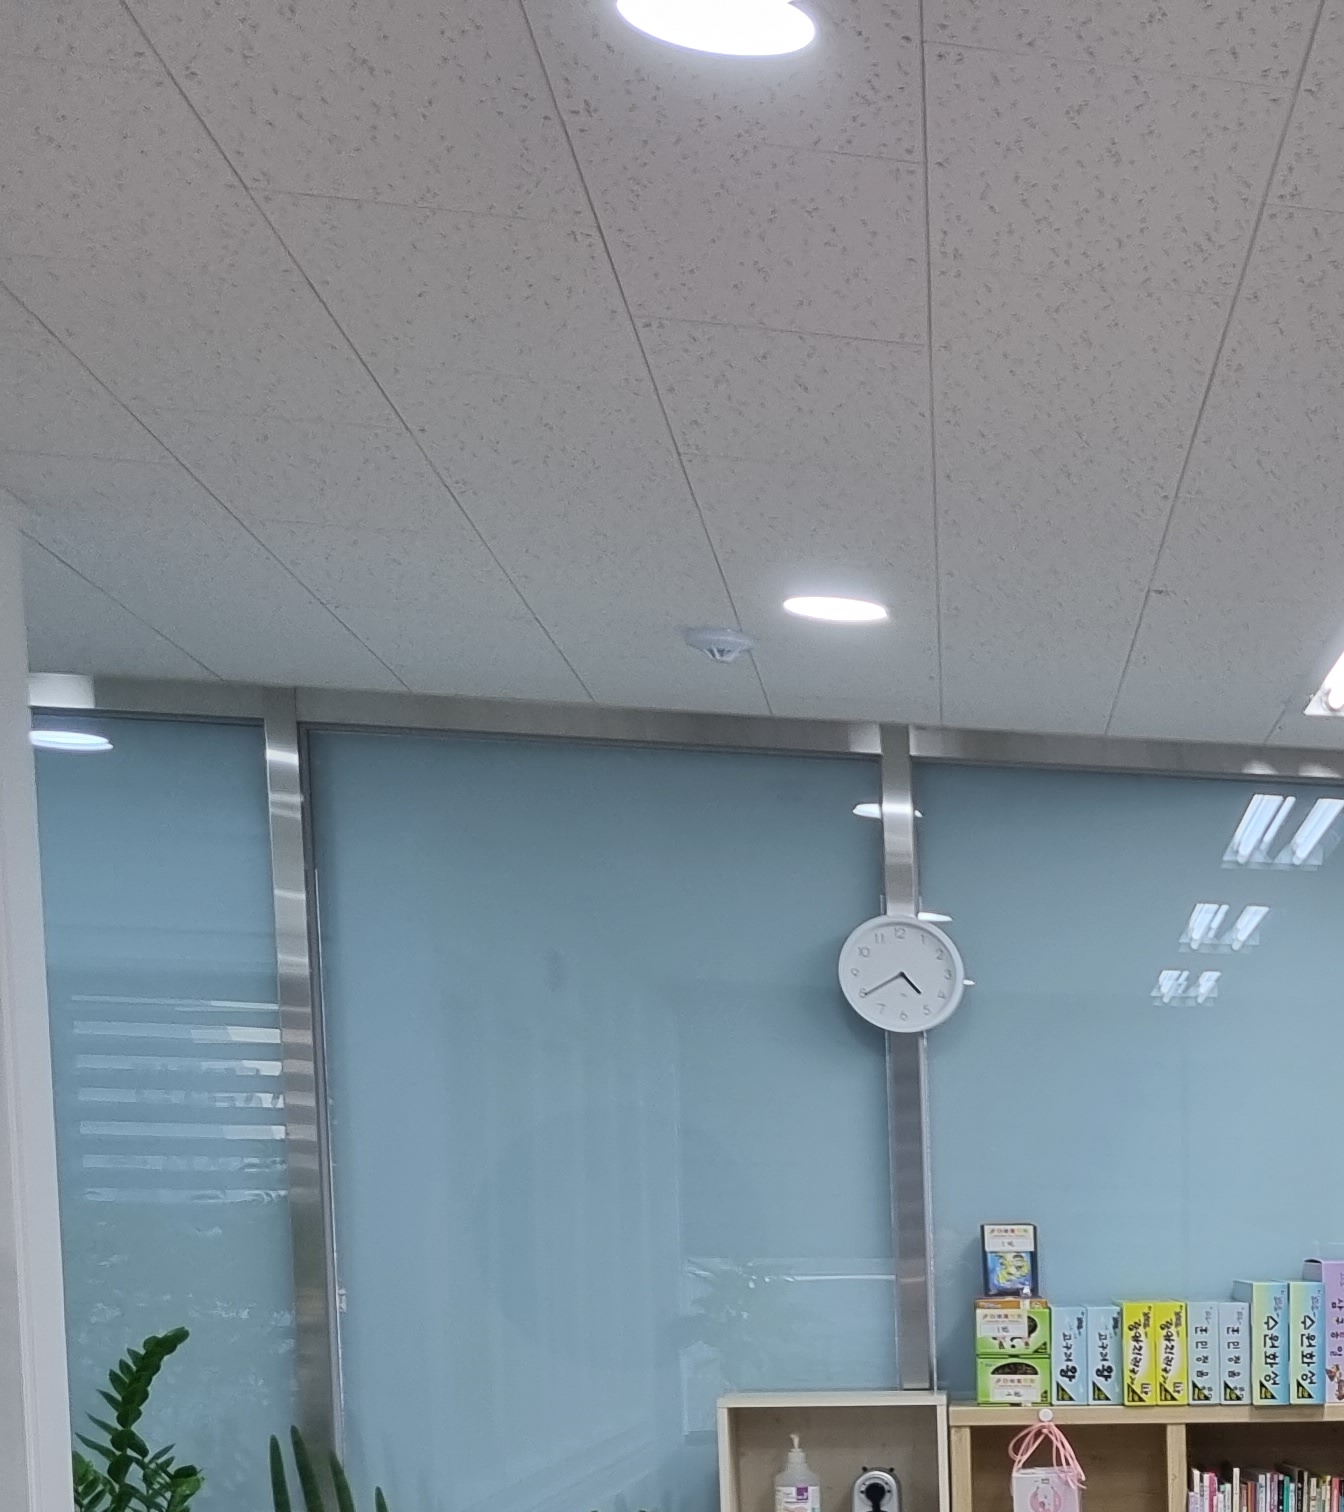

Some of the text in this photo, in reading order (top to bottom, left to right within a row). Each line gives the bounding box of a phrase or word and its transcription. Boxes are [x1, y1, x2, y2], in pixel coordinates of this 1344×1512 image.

[874, 933, 886, 944] 11
[894, 927, 906, 940] 12
[858, 946, 870, 958] 10
[935, 948, 945, 961] 2
[850, 967, 860, 977] 9
[944, 968, 952, 981] 3
[877, 1002, 886, 1015] 7
[923, 1004, 931, 1016] 5
[899, 1010, 908, 1021] 6
[1095, 1332, 1113, 1381] 고구려 왕
[1195, 1326, 1209, 1378] 훈민정음
[1227, 1326, 1241, 1378] 훈민정음
[1263, 1315, 1280, 1386] 수원화성
[1301, 1315, 1317, 1385] 수원화성
[1060, 1332, 1077, 1382] 고구려 왕
